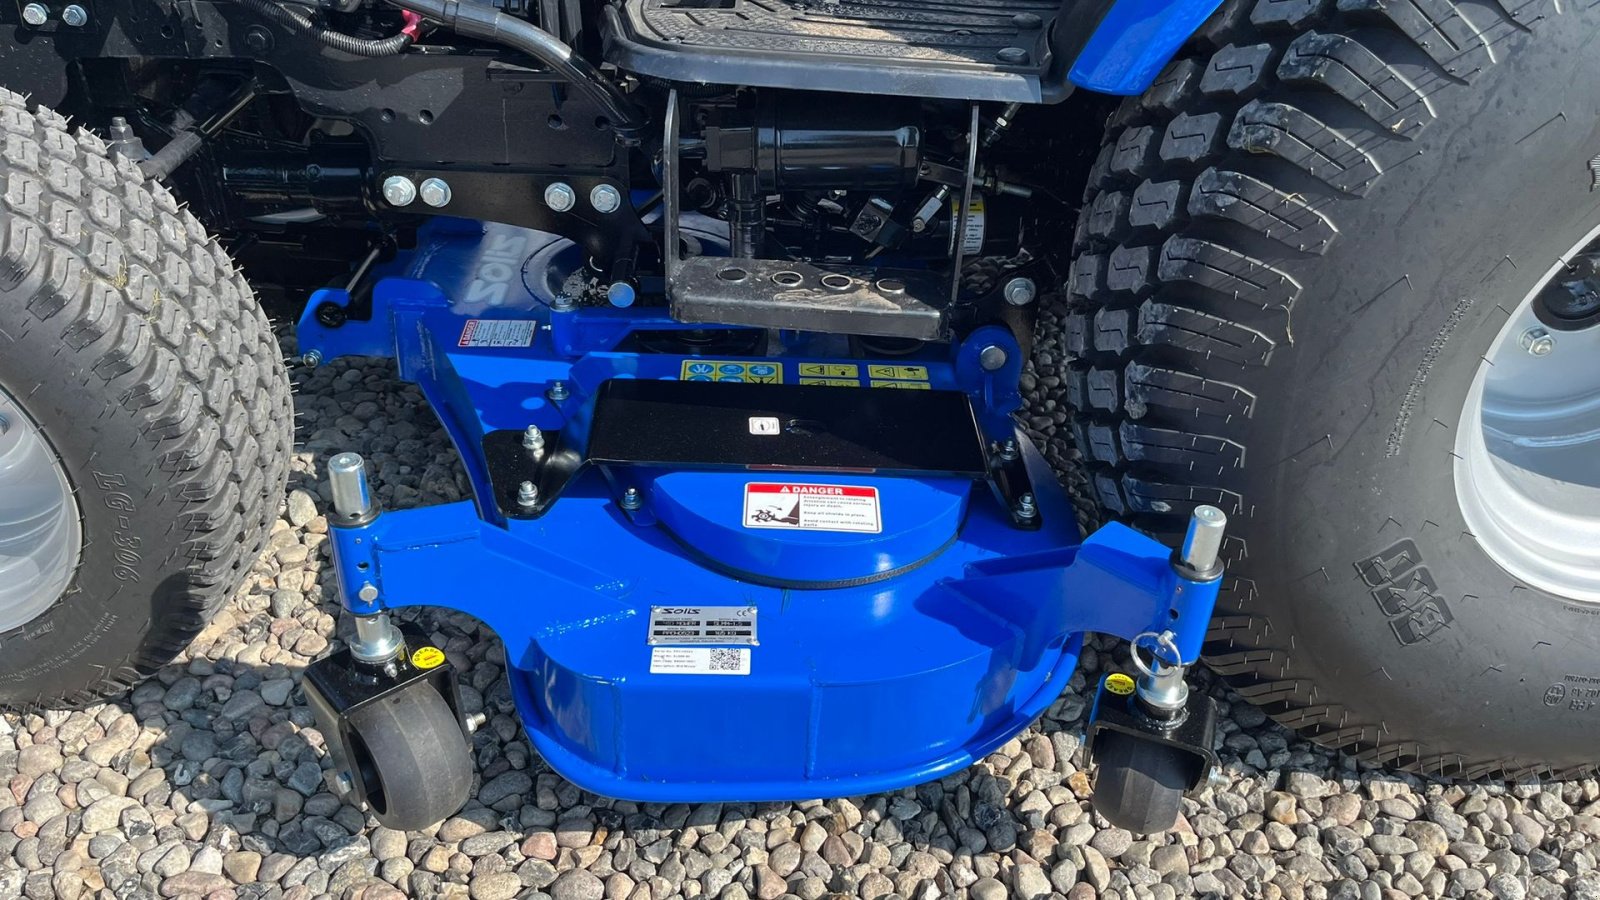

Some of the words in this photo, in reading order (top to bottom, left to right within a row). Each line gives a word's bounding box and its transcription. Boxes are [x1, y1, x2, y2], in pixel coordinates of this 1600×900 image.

[93, 470, 142, 583] LG-306
[792, 486, 843, 495] DANGER
[1356, 542, 1452, 645] BKT
